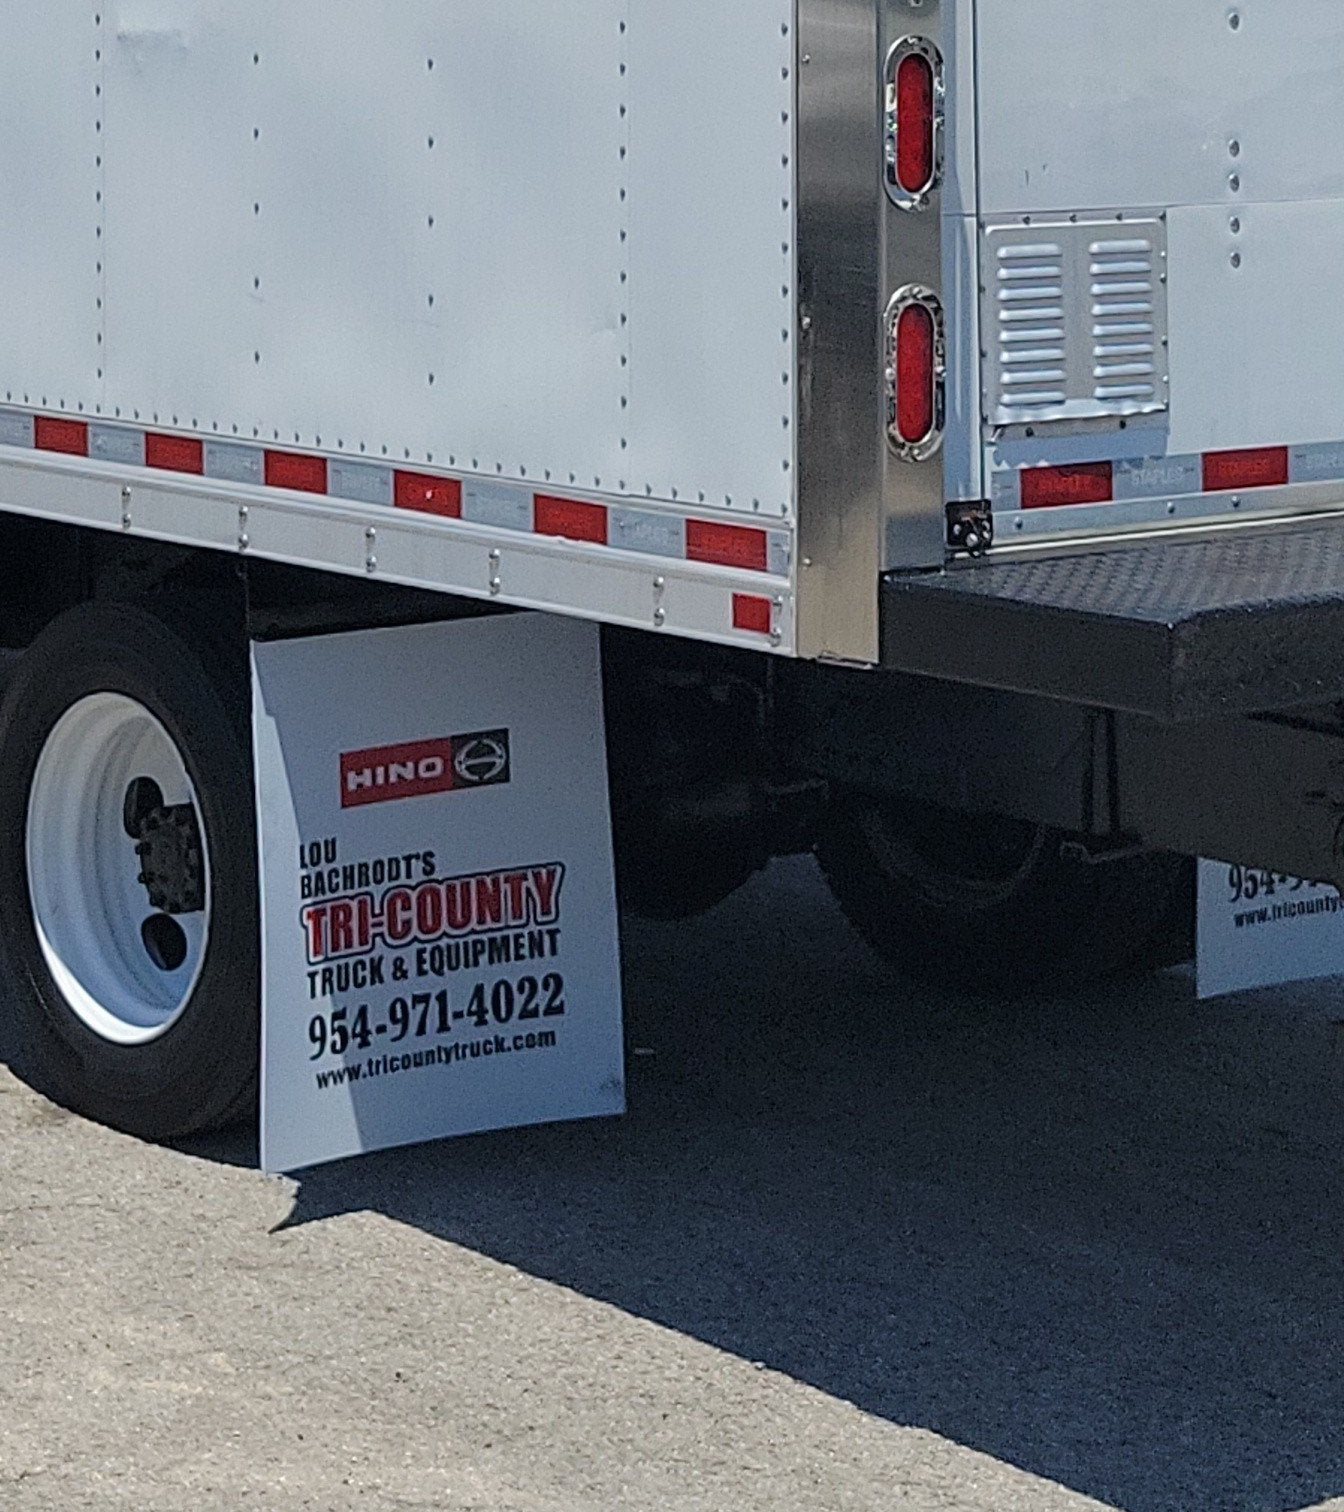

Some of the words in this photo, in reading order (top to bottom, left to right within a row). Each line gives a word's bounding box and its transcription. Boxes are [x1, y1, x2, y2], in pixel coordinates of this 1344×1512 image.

[347, 755, 444, 792] HINO
[299, 838, 337, 869] LOU
[300, 851, 436, 899] BACHRODT'S
[302, 863, 564, 964] TRI-COUNTY
[307, 955, 384, 999] TRUCK
[392, 957, 410, 980] &
[416, 928, 561, 976] EQUIPMENT
[308, 973, 565, 1060] 954-971-4022
[315, 1029, 556, 1090] www.tricountytruck.com
